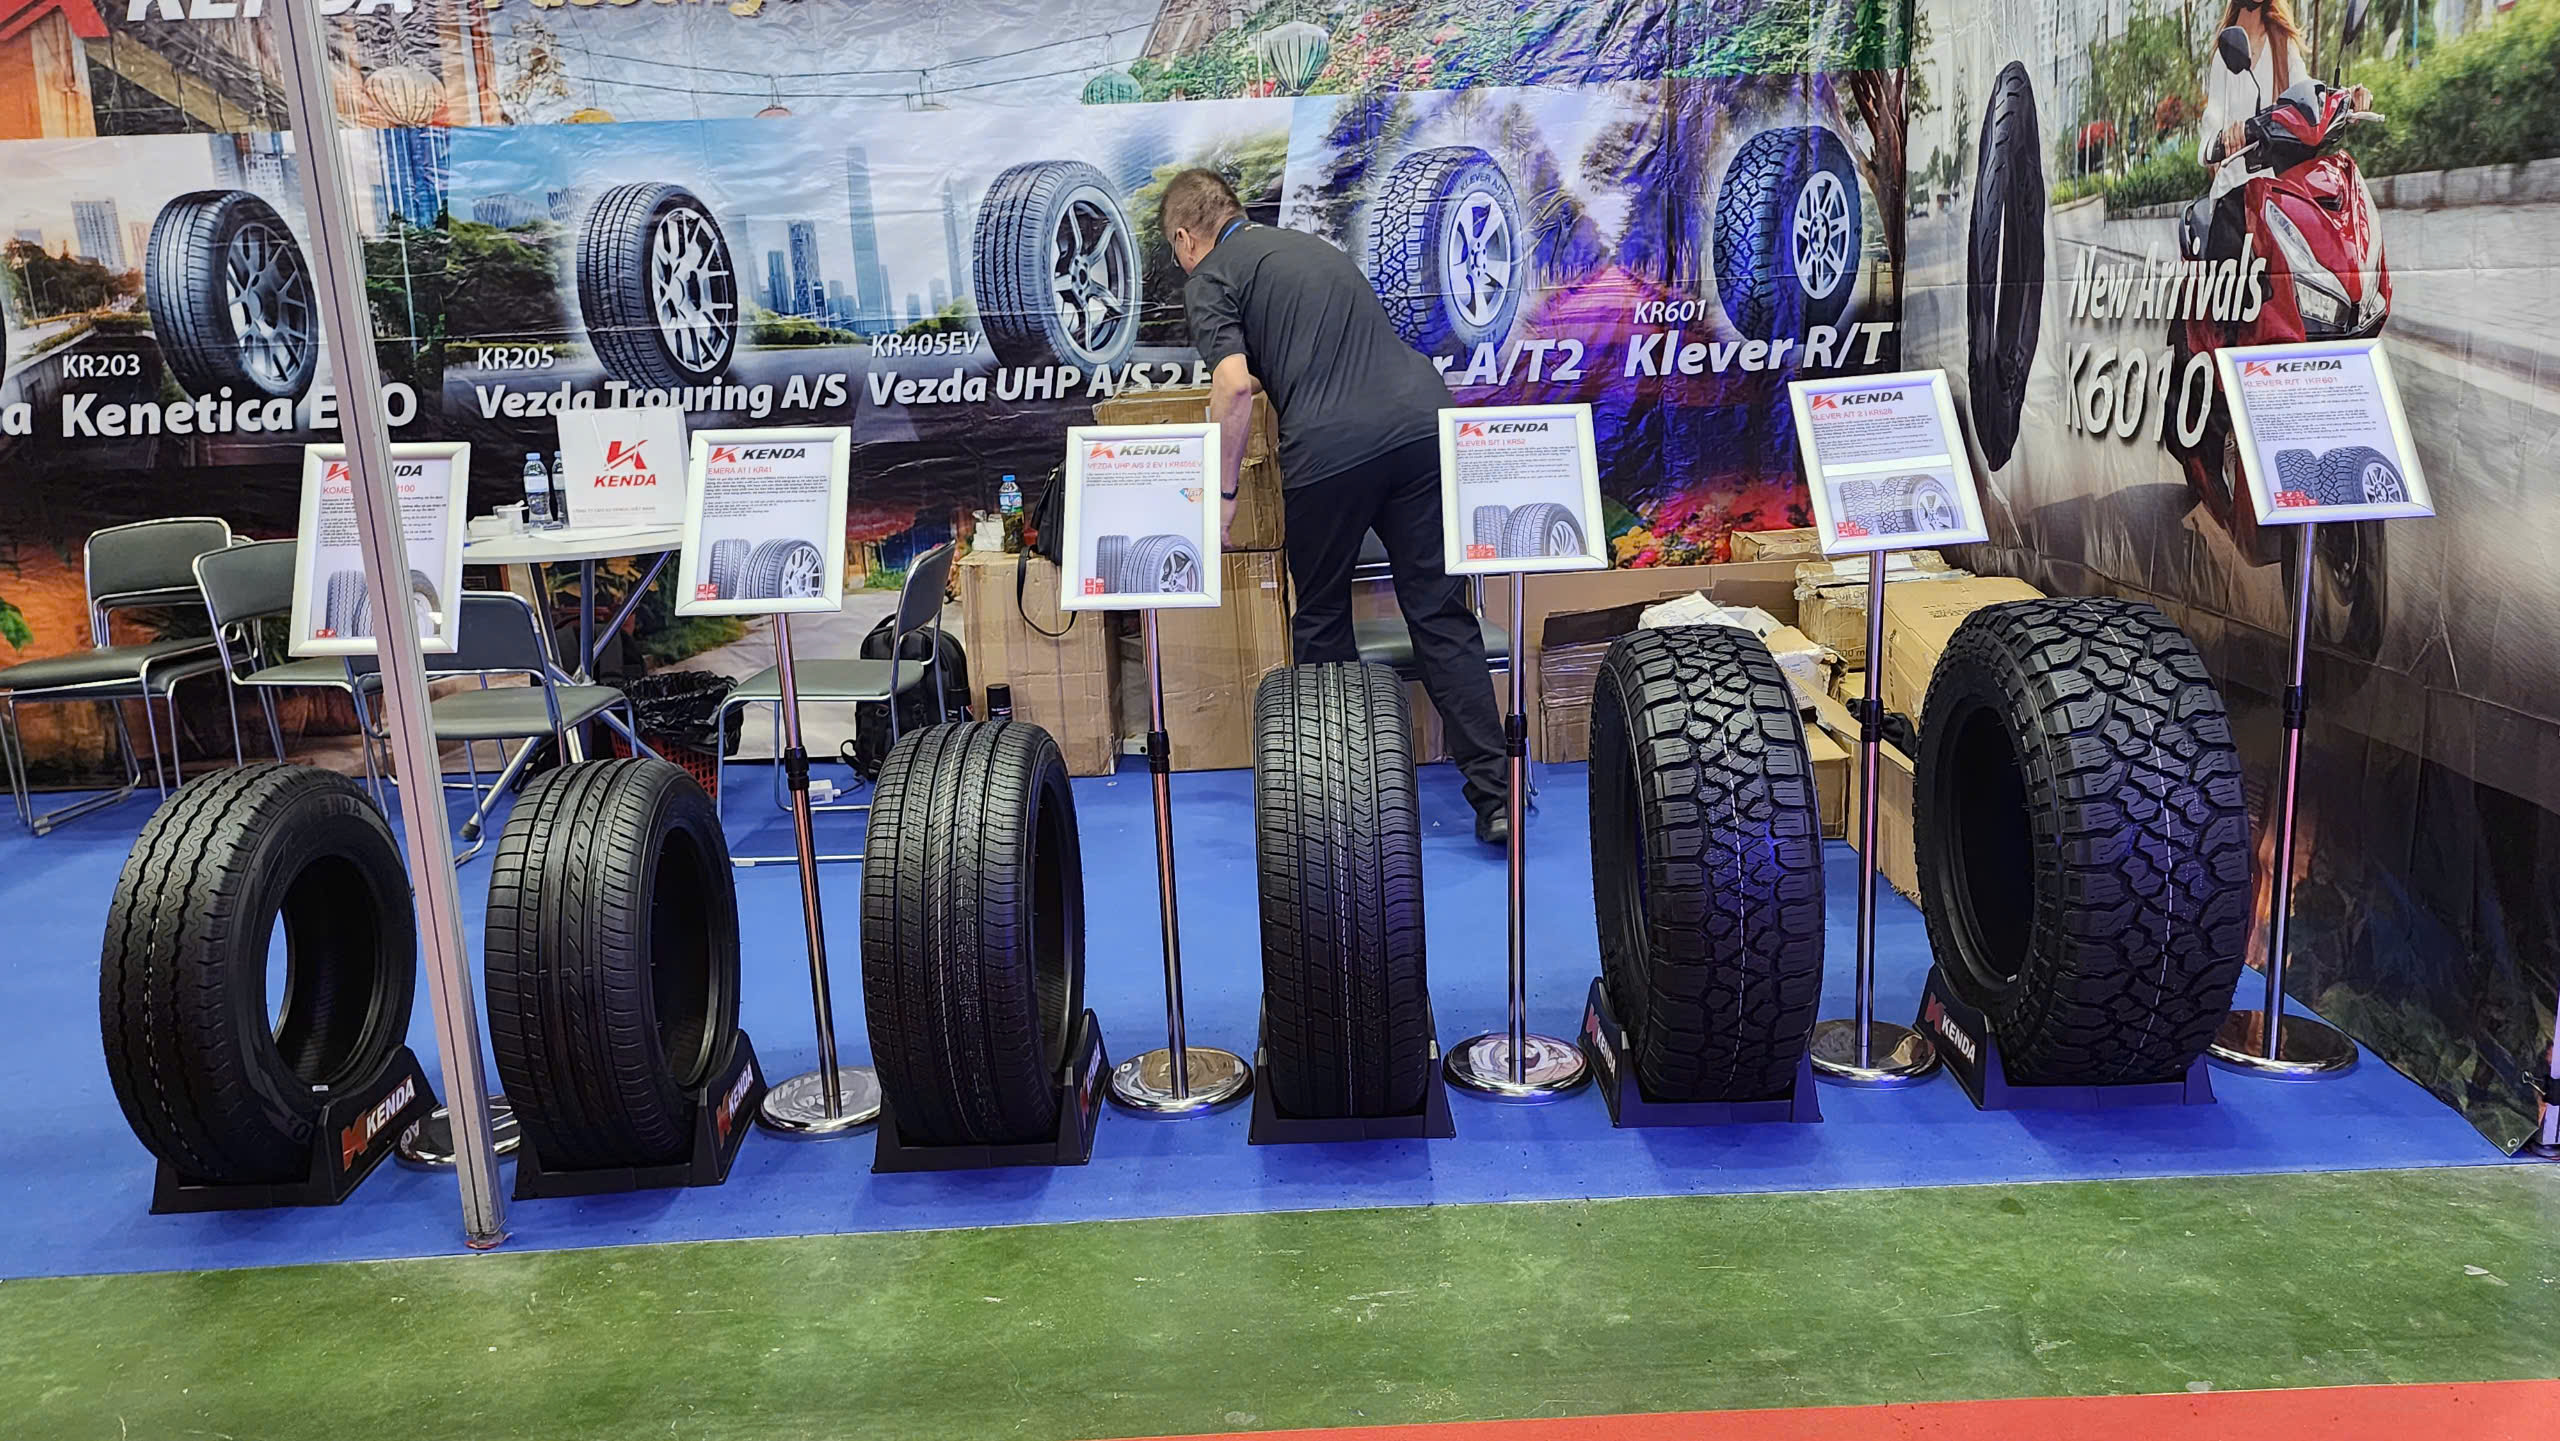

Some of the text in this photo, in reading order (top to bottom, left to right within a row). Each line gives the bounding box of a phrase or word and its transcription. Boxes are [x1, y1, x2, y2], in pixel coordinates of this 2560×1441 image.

[2067, 232, 2267, 323] New Arrivals
[1633, 298, 1708, 325] KR601
[871, 330, 981, 358] KR405EV
[1623, 321, 1895, 378] Klever R/T
[62, 352, 142, 379] KR203
[477, 347, 555, 371] KR205
[1460, 338, 1586, 387] A/T2
[2275, 359, 2343, 373] KENDA
[475, 373, 848, 419] Vezda Trouring A/S
[868, 368, 987, 406] Vezda
[996, 364, 1082, 401] UHP
[1086, 362, 1154, 398] A/S
[1161, 363, 1182, 388] 2
[2064, 342, 2215, 448] K6010
[2244, 380, 2282, 388] KLEVER
[62, 385, 295, 438] Kenetica
[309, 381, 418, 430] EO
[1841, 391, 1904, 405] KENDA
[1488, 422, 1549, 434] KENDA
[1810, 412, 1841, 421] KLEVER
[741, 448, 806, 460] KENDA
[1119, 444, 1181, 456] KENDA
[1456, 440, 1486, 448] KLEVER
[593, 473, 657, 488] KENDA
[708, 467, 736, 475] EMERA
[1942, 1014, 1977, 1065] KENDA
[1596, 1027, 1616, 1080] KENDA
[728, 1062, 754, 1120] KENDA
[366, 1077, 416, 1140] KENDA
